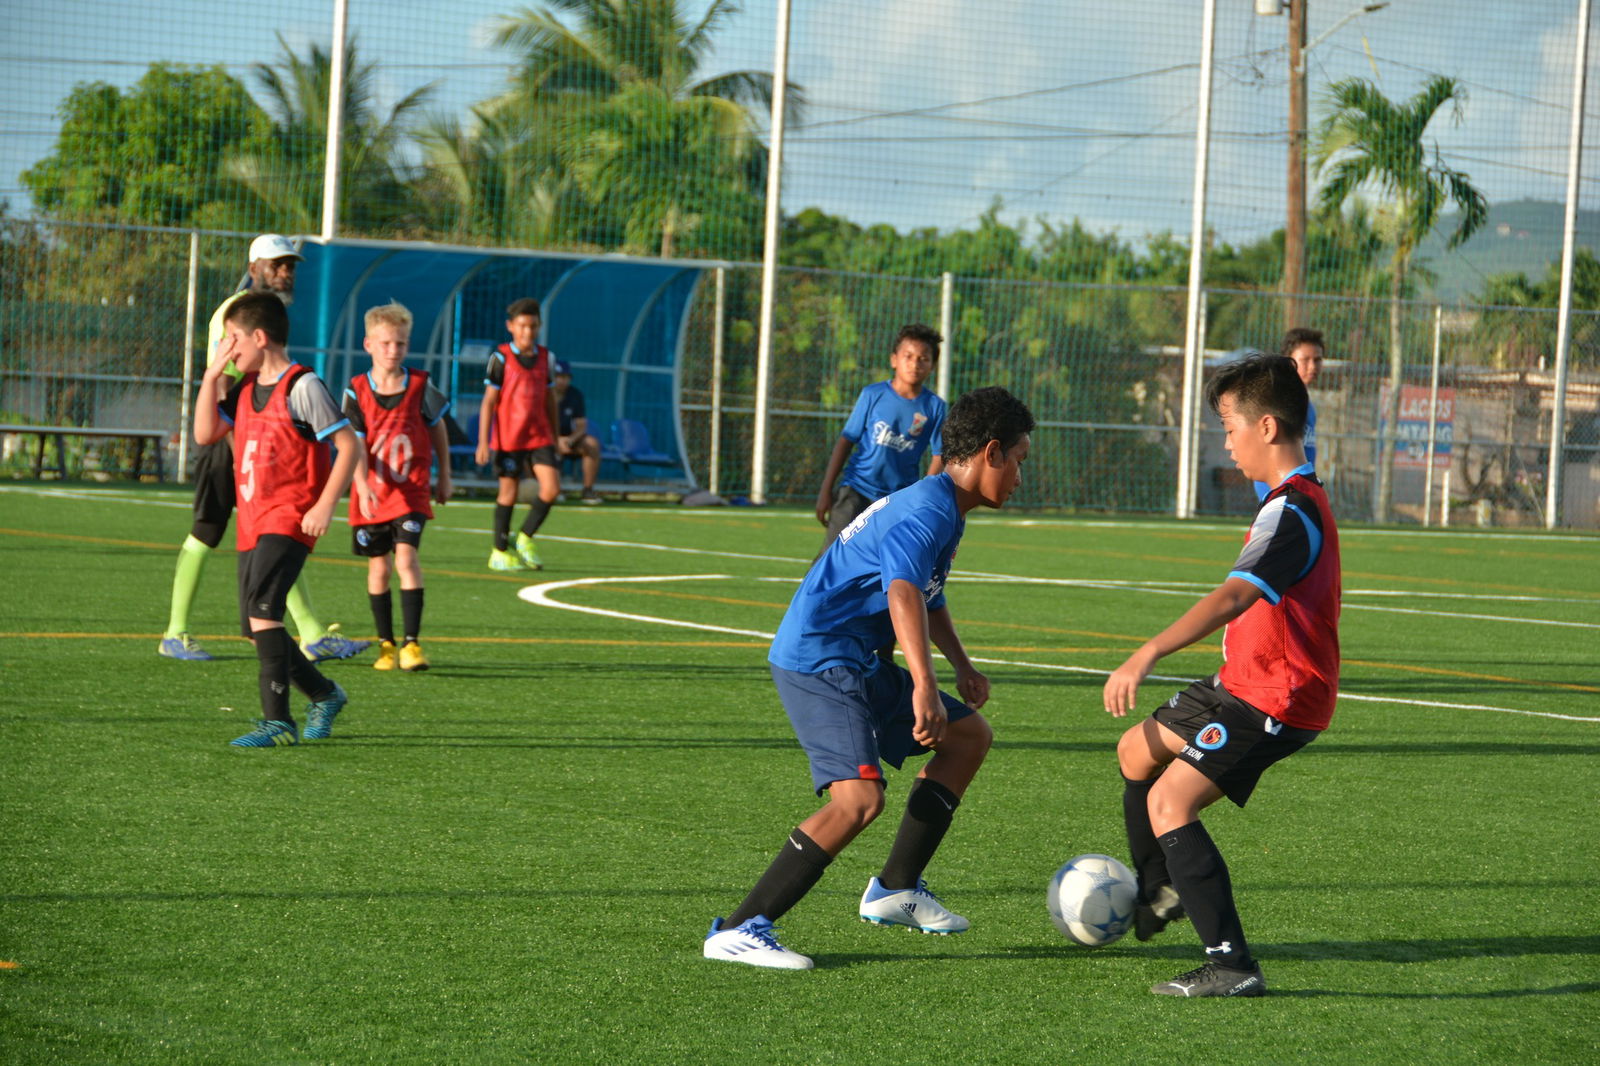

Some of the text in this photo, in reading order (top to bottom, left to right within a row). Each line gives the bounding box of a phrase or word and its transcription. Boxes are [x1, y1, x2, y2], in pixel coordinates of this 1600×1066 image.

[239, 439, 259, 503] 5
[370, 433, 414, 484] 10
[1223, 976, 1259, 997] ULTRA
